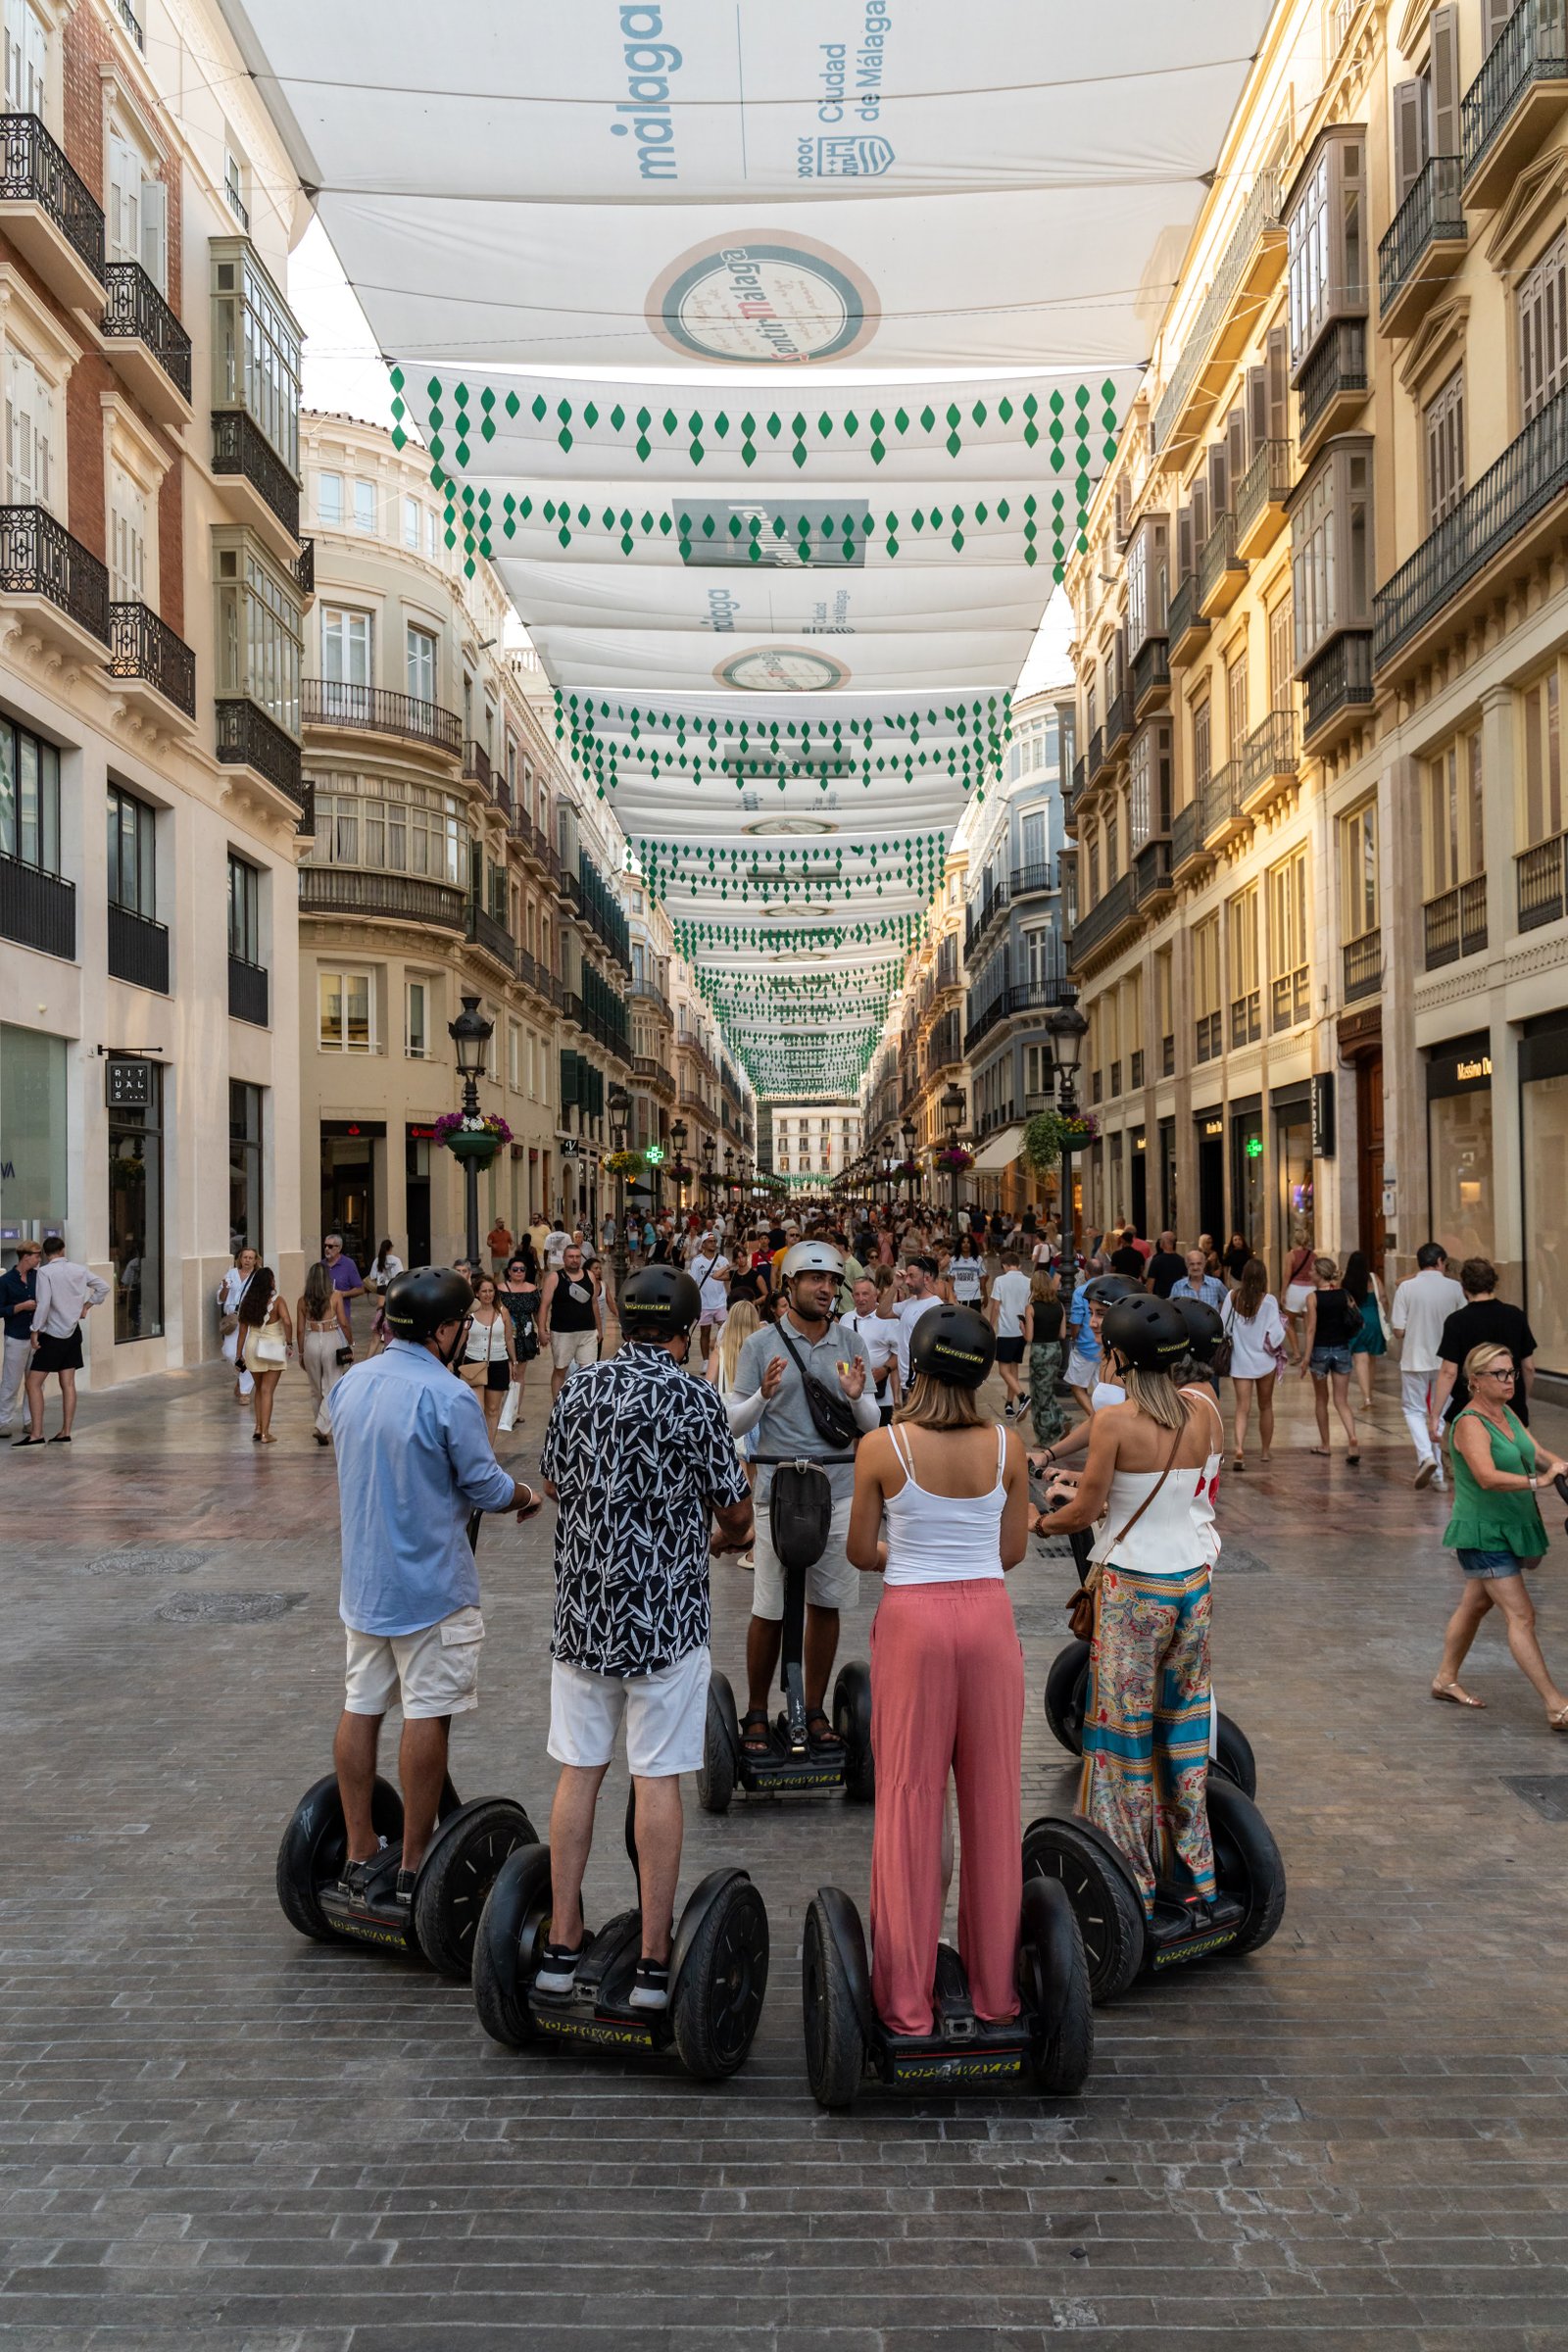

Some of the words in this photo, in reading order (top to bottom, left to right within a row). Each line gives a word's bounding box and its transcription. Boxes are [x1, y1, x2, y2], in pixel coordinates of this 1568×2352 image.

[856, 0, 892, 88] Málaga
[610, 4, 683, 180] málaga
[818, 43, 847, 123] Ciudad
[855, 94, 881, 122] de
[813, 603, 826, 624] Ciudad
[834, 590, 851, 616] Málaga
[1457, 1060, 1482, 1081] Massimo
